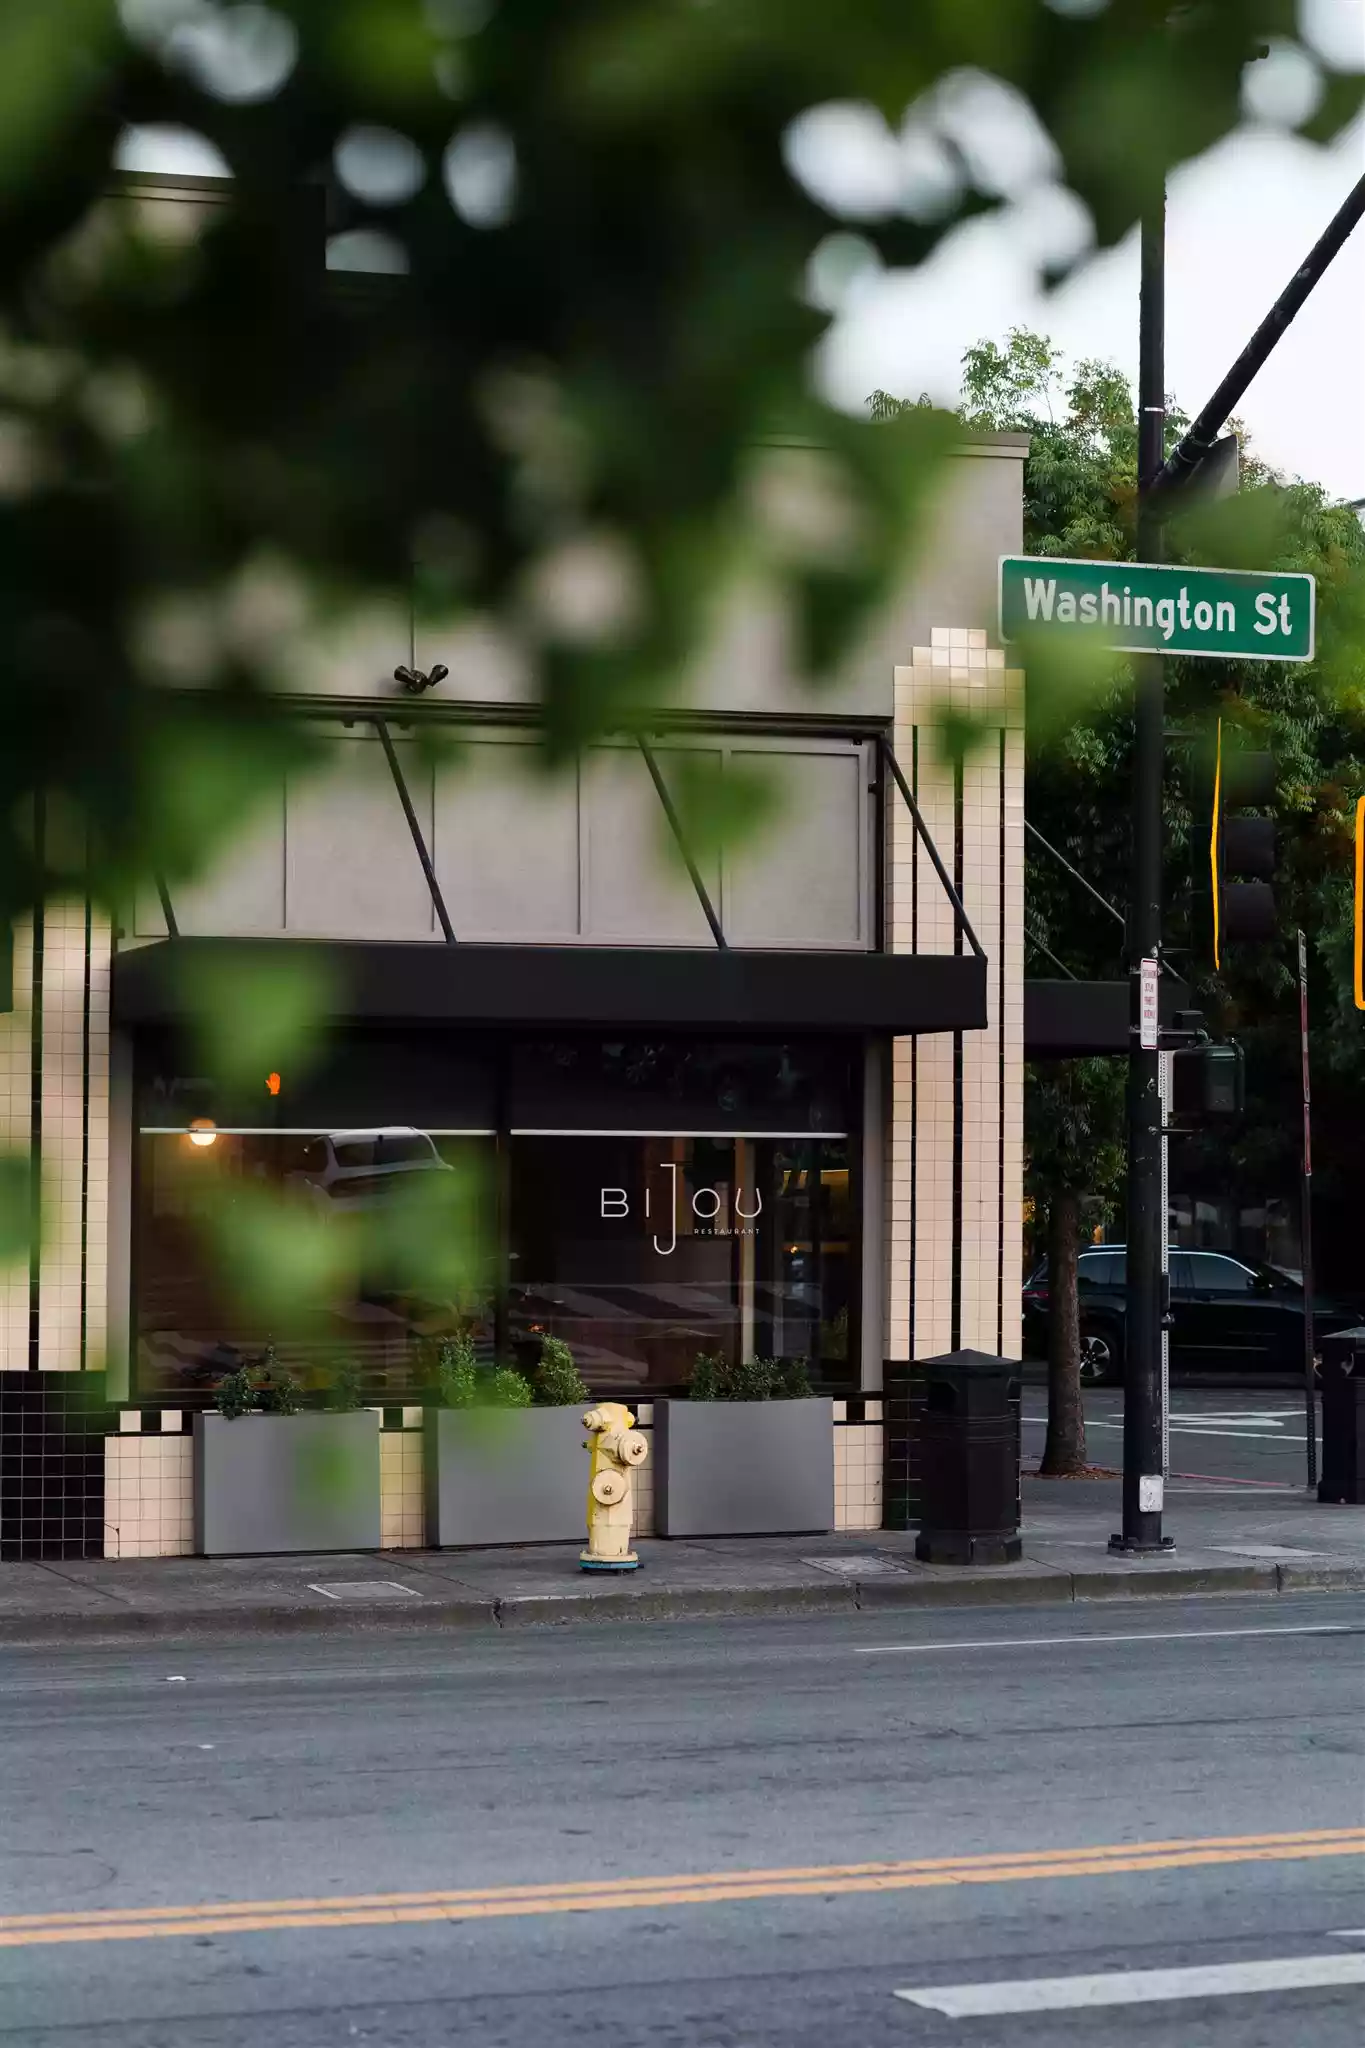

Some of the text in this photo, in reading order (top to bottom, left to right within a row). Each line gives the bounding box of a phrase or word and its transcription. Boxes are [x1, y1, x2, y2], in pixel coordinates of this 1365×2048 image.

[1023, 577, 1293, 641] Washington St
[601, 1163, 762, 1255] BIJOU
[693, 1227, 760, 1235] RESTAURANT
